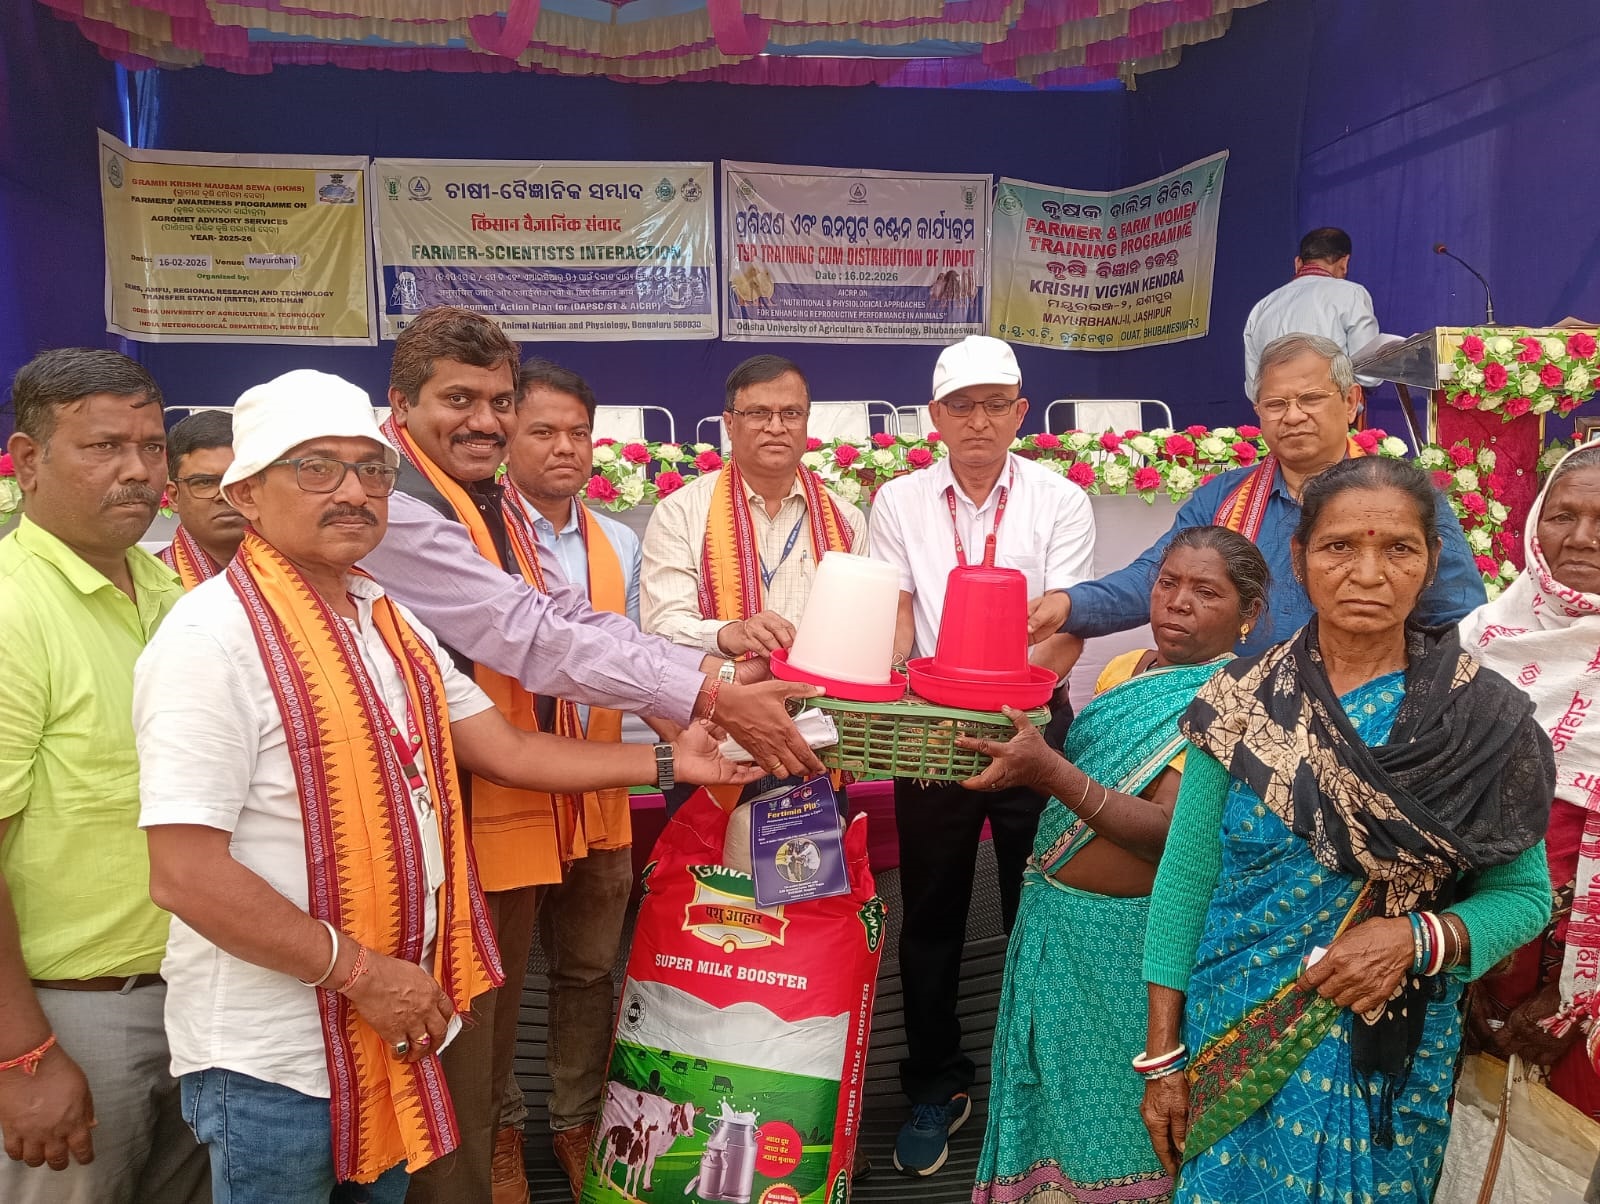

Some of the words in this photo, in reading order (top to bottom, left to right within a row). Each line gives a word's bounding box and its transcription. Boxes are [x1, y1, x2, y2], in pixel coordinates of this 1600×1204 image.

[131, 178, 167, 187] GRAMIN
[170, 180, 201, 188] KRISHI
[204, 182, 243, 190] MAUSAM
[177, 198, 232, 206] AWARENESS
[1041, 200, 1102, 219] କୃଷକ
[1110, 194, 1152, 218] ତାଲିମ
[471, 212, 519, 231] किसान
[584, 214, 623, 232] संवाद
[791, 213, 816, 236] ଏବଂ
[1025, 217, 1102, 241] FARMER
[1106, 226, 1118, 241] &
[1120, 215, 1151, 238] FARM
[1154, 200, 1199, 228] WOMEN
[1028, 236, 1117, 259] TRAINING
[1120, 221, 1192, 255] PROGRAMME
[159, 258, 207, 266] 16-02-2026
[411, 245, 575, 260] FARMER-SCIENTISTS
[580, 245, 681, 260] INTERACTION
[737, 243, 757, 262] TSP
[760, 244, 814, 264] TRAINING
[818, 246, 843, 265] CUM
[847, 247, 922, 267] DISTRIBUTION
[926, 248, 939, 267] OF
[942, 249, 975, 267] INPUT
[815, 270, 837, 280] Date
[844, 271, 898, 281] 16.02.2026
[1046, 259, 1087, 280] କୃଷି
[838, 289, 857, 297] AICRP
[858, 289, 868, 297] ON
[1029, 279, 1089, 299] KRISHI
[1095, 280, 1139, 299] VIGYAN
[1142, 269, 1184, 292] KENDRA
[500, 303, 529, 311] Action
[532, 303, 552, 311] Plan
[555, 303, 568, 311] for
[571, 302, 617, 311] (DAPSC/ST
[630, 302, 661, 311] AICRP)
[757, 308, 769, 316] FOR
[771, 309, 809, 317] ENHANCING
[810, 310, 858, 319] REPRODUCTIVE
[858, 311, 905, 319] PERFORMANCE
[832, 299, 882, 308] PHYSIOLOGICAL
[883, 300, 926, 308] APPROACHES
[501, 321, 529, 330] Animal
[532, 321, 566, 330] Nutrition
[569, 321, 583, 329] and
[586, 321, 630, 330] Physiology,
[632, 320, 671, 329] Bengaluru
[1042, 311, 1131, 327] MAYURBHANJ-II,
[1133, 306, 1172, 323] JASHIPUR
[736, 322, 764, 331] Odisha
[766, 322, 807, 333] University
[808, 324, 817, 332] of
[819, 325, 864, 334] Agriculture
[866, 325, 873, 333] &
[874, 326, 921, 335] Technology,
[923, 326, 977, 334] Bhubaneswar
[1144, 318, 1199, 338] BHUBANESWAR-3
[767, 806, 802, 819] Fertimin
[803, 799, 821, 812] Plus
[706, 906, 724, 924] पशु
[726, 909, 762, 925] आहार
[655, 953, 693, 972] SUPER
[696, 959, 734, 979] MILK
[736, 966, 808, 991] BOOSTER
[850, 1049, 862, 1086] MILK
[856, 983, 870, 1046] BOOSTER
